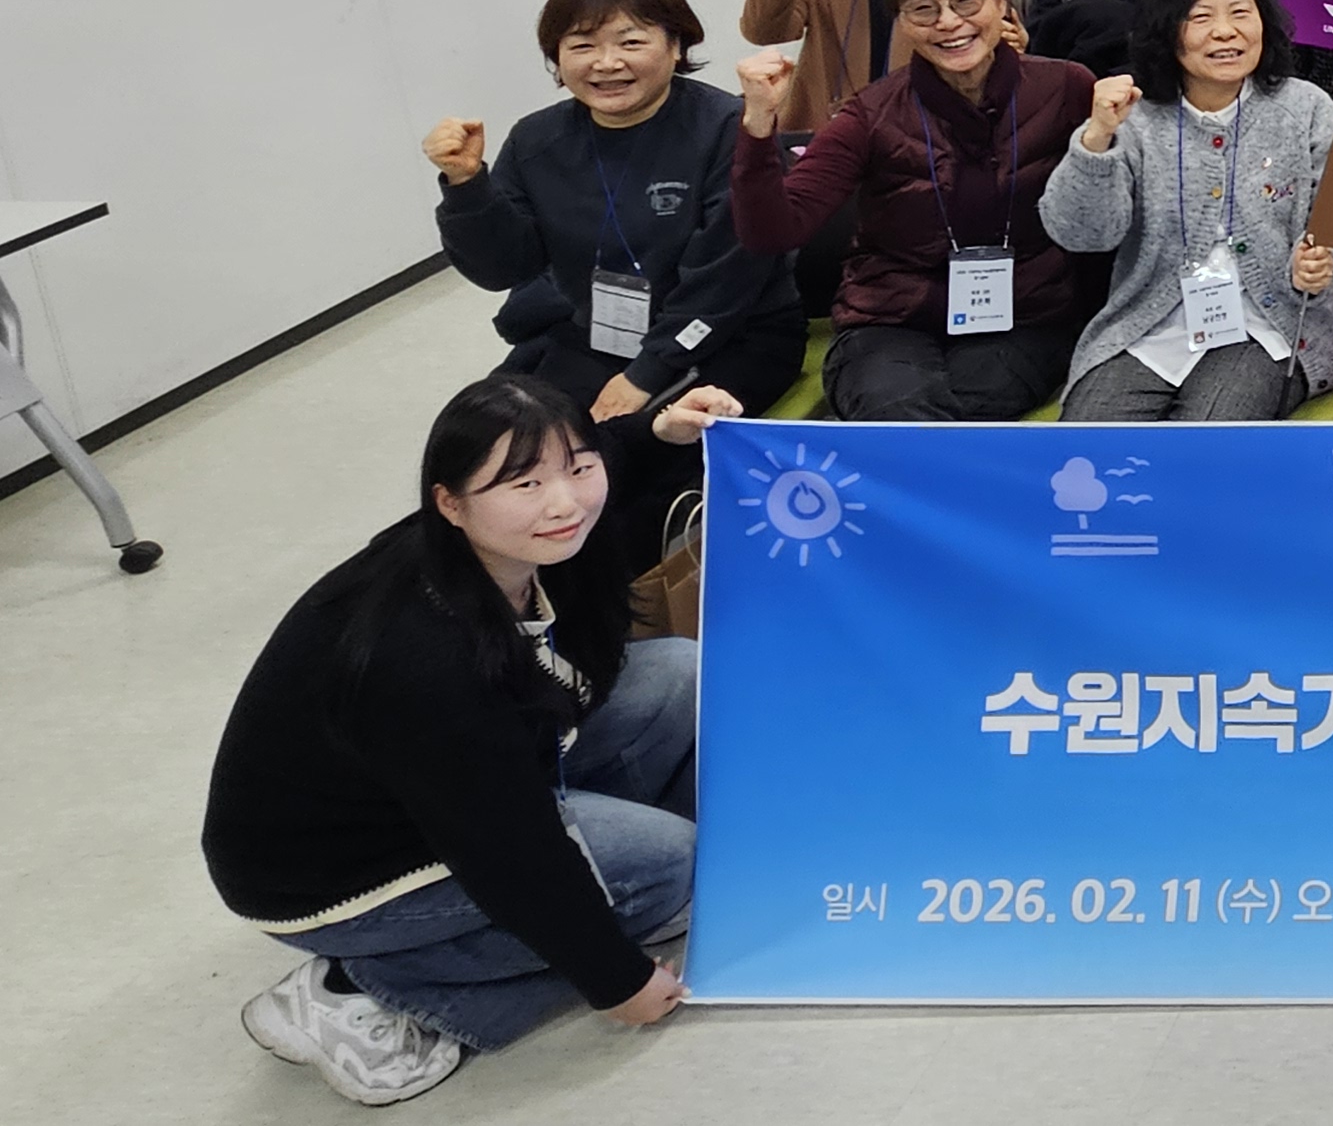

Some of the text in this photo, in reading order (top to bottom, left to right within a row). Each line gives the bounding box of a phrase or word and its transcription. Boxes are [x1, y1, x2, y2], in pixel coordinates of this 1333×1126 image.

[821, 881, 887, 921] 일시
[917, 878, 1057, 923] 2026.
[1071, 878, 1144, 922] 02.
[1162, 878, 1200, 922] 11
[1217, 876, 1281, 924] (수)
